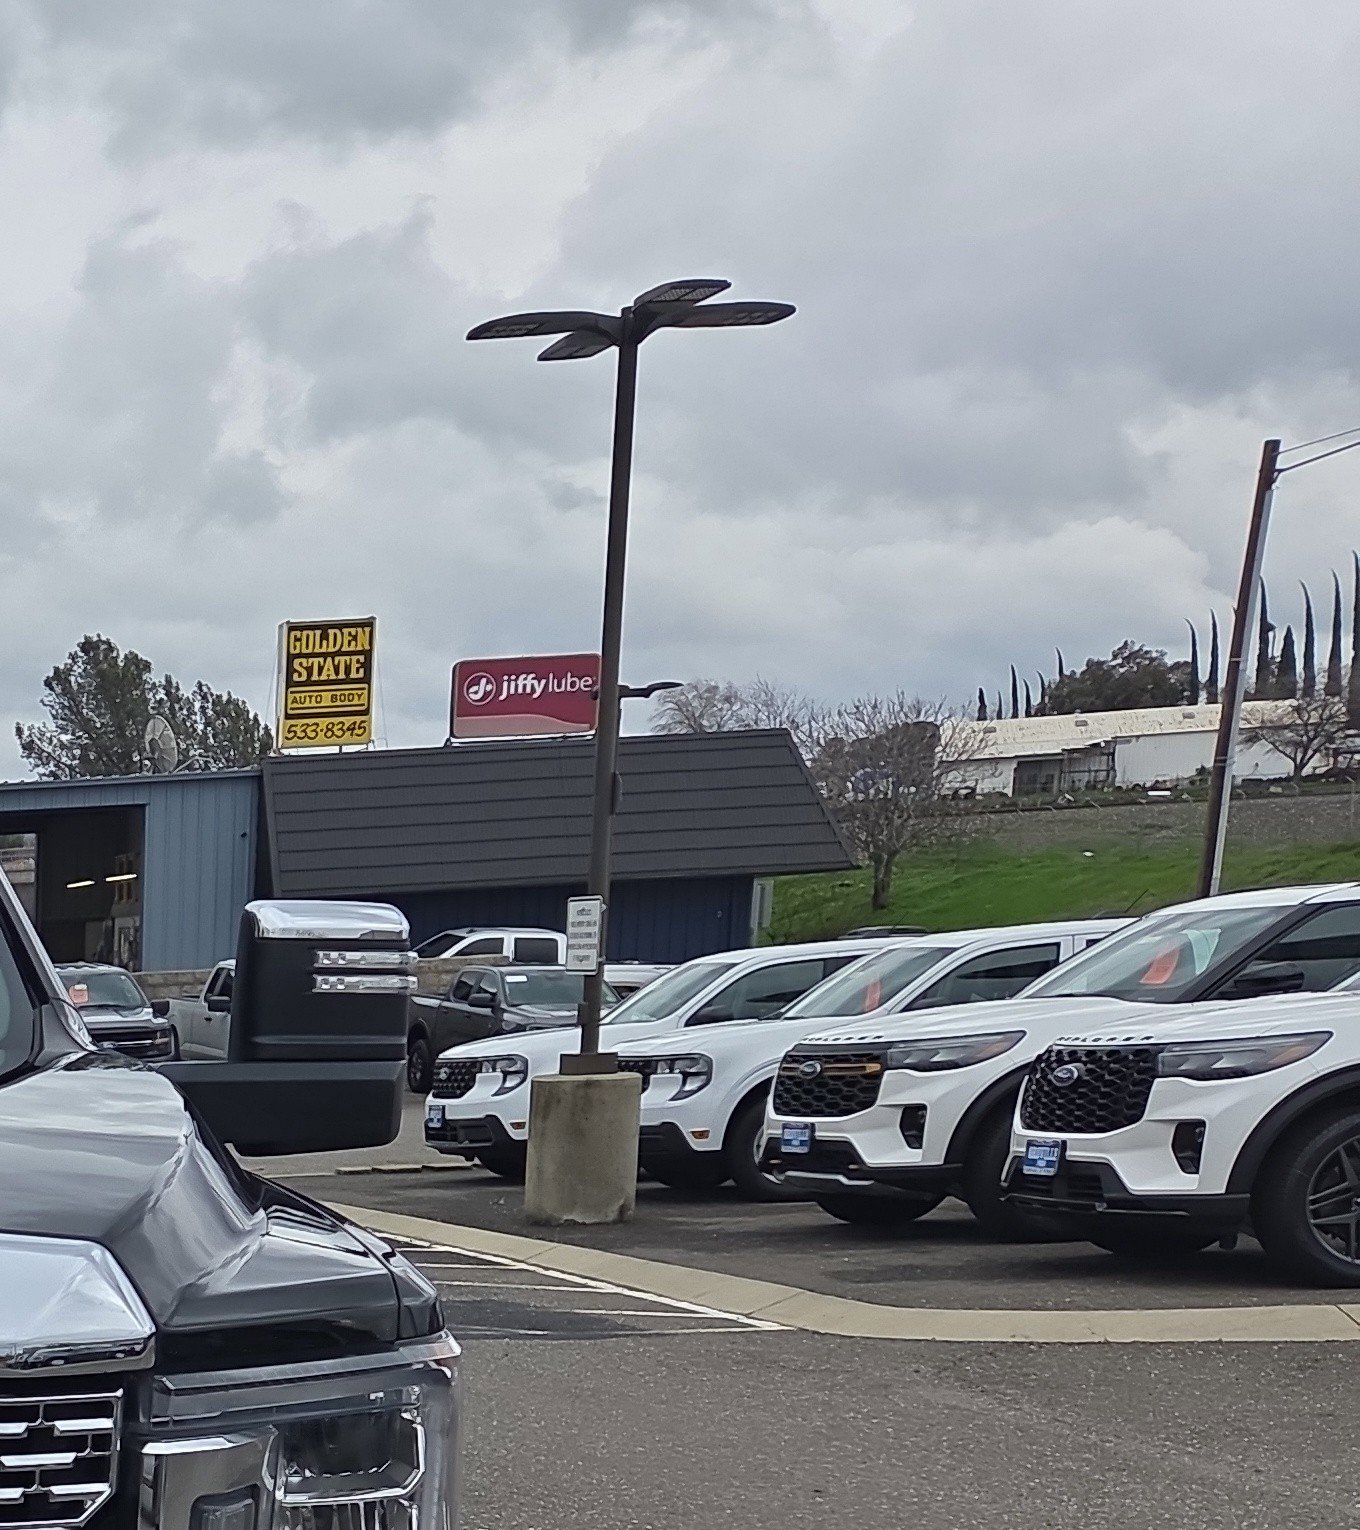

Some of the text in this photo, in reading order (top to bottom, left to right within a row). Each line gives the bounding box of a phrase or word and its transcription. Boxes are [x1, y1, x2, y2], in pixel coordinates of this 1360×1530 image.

[289, 627, 372, 655] GOLDEN
[292, 655, 365, 682] STATE
[290, 692, 365, 705] AUTO BODY
